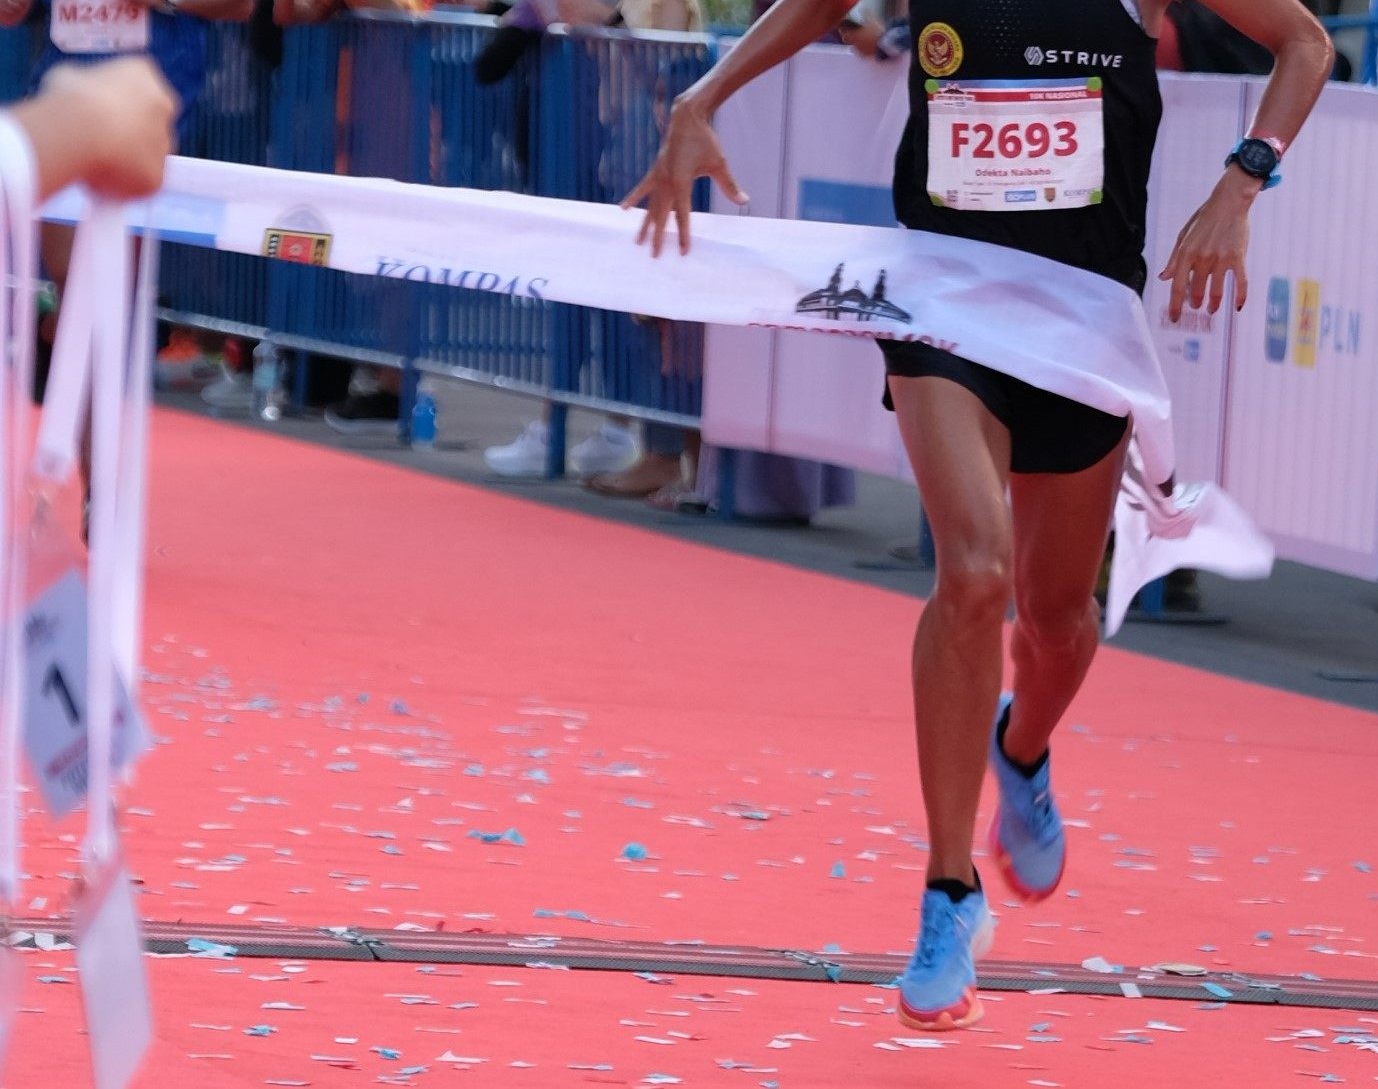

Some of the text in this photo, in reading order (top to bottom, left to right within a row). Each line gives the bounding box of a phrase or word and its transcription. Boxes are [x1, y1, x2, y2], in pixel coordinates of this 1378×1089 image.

[1045, 49, 1123, 68] STRIVE
[1045, 90, 1088, 100] NASIONAL
[951, 121, 1078, 159] F2693
[975, 168, 1052, 177] Odekta Naibaho
